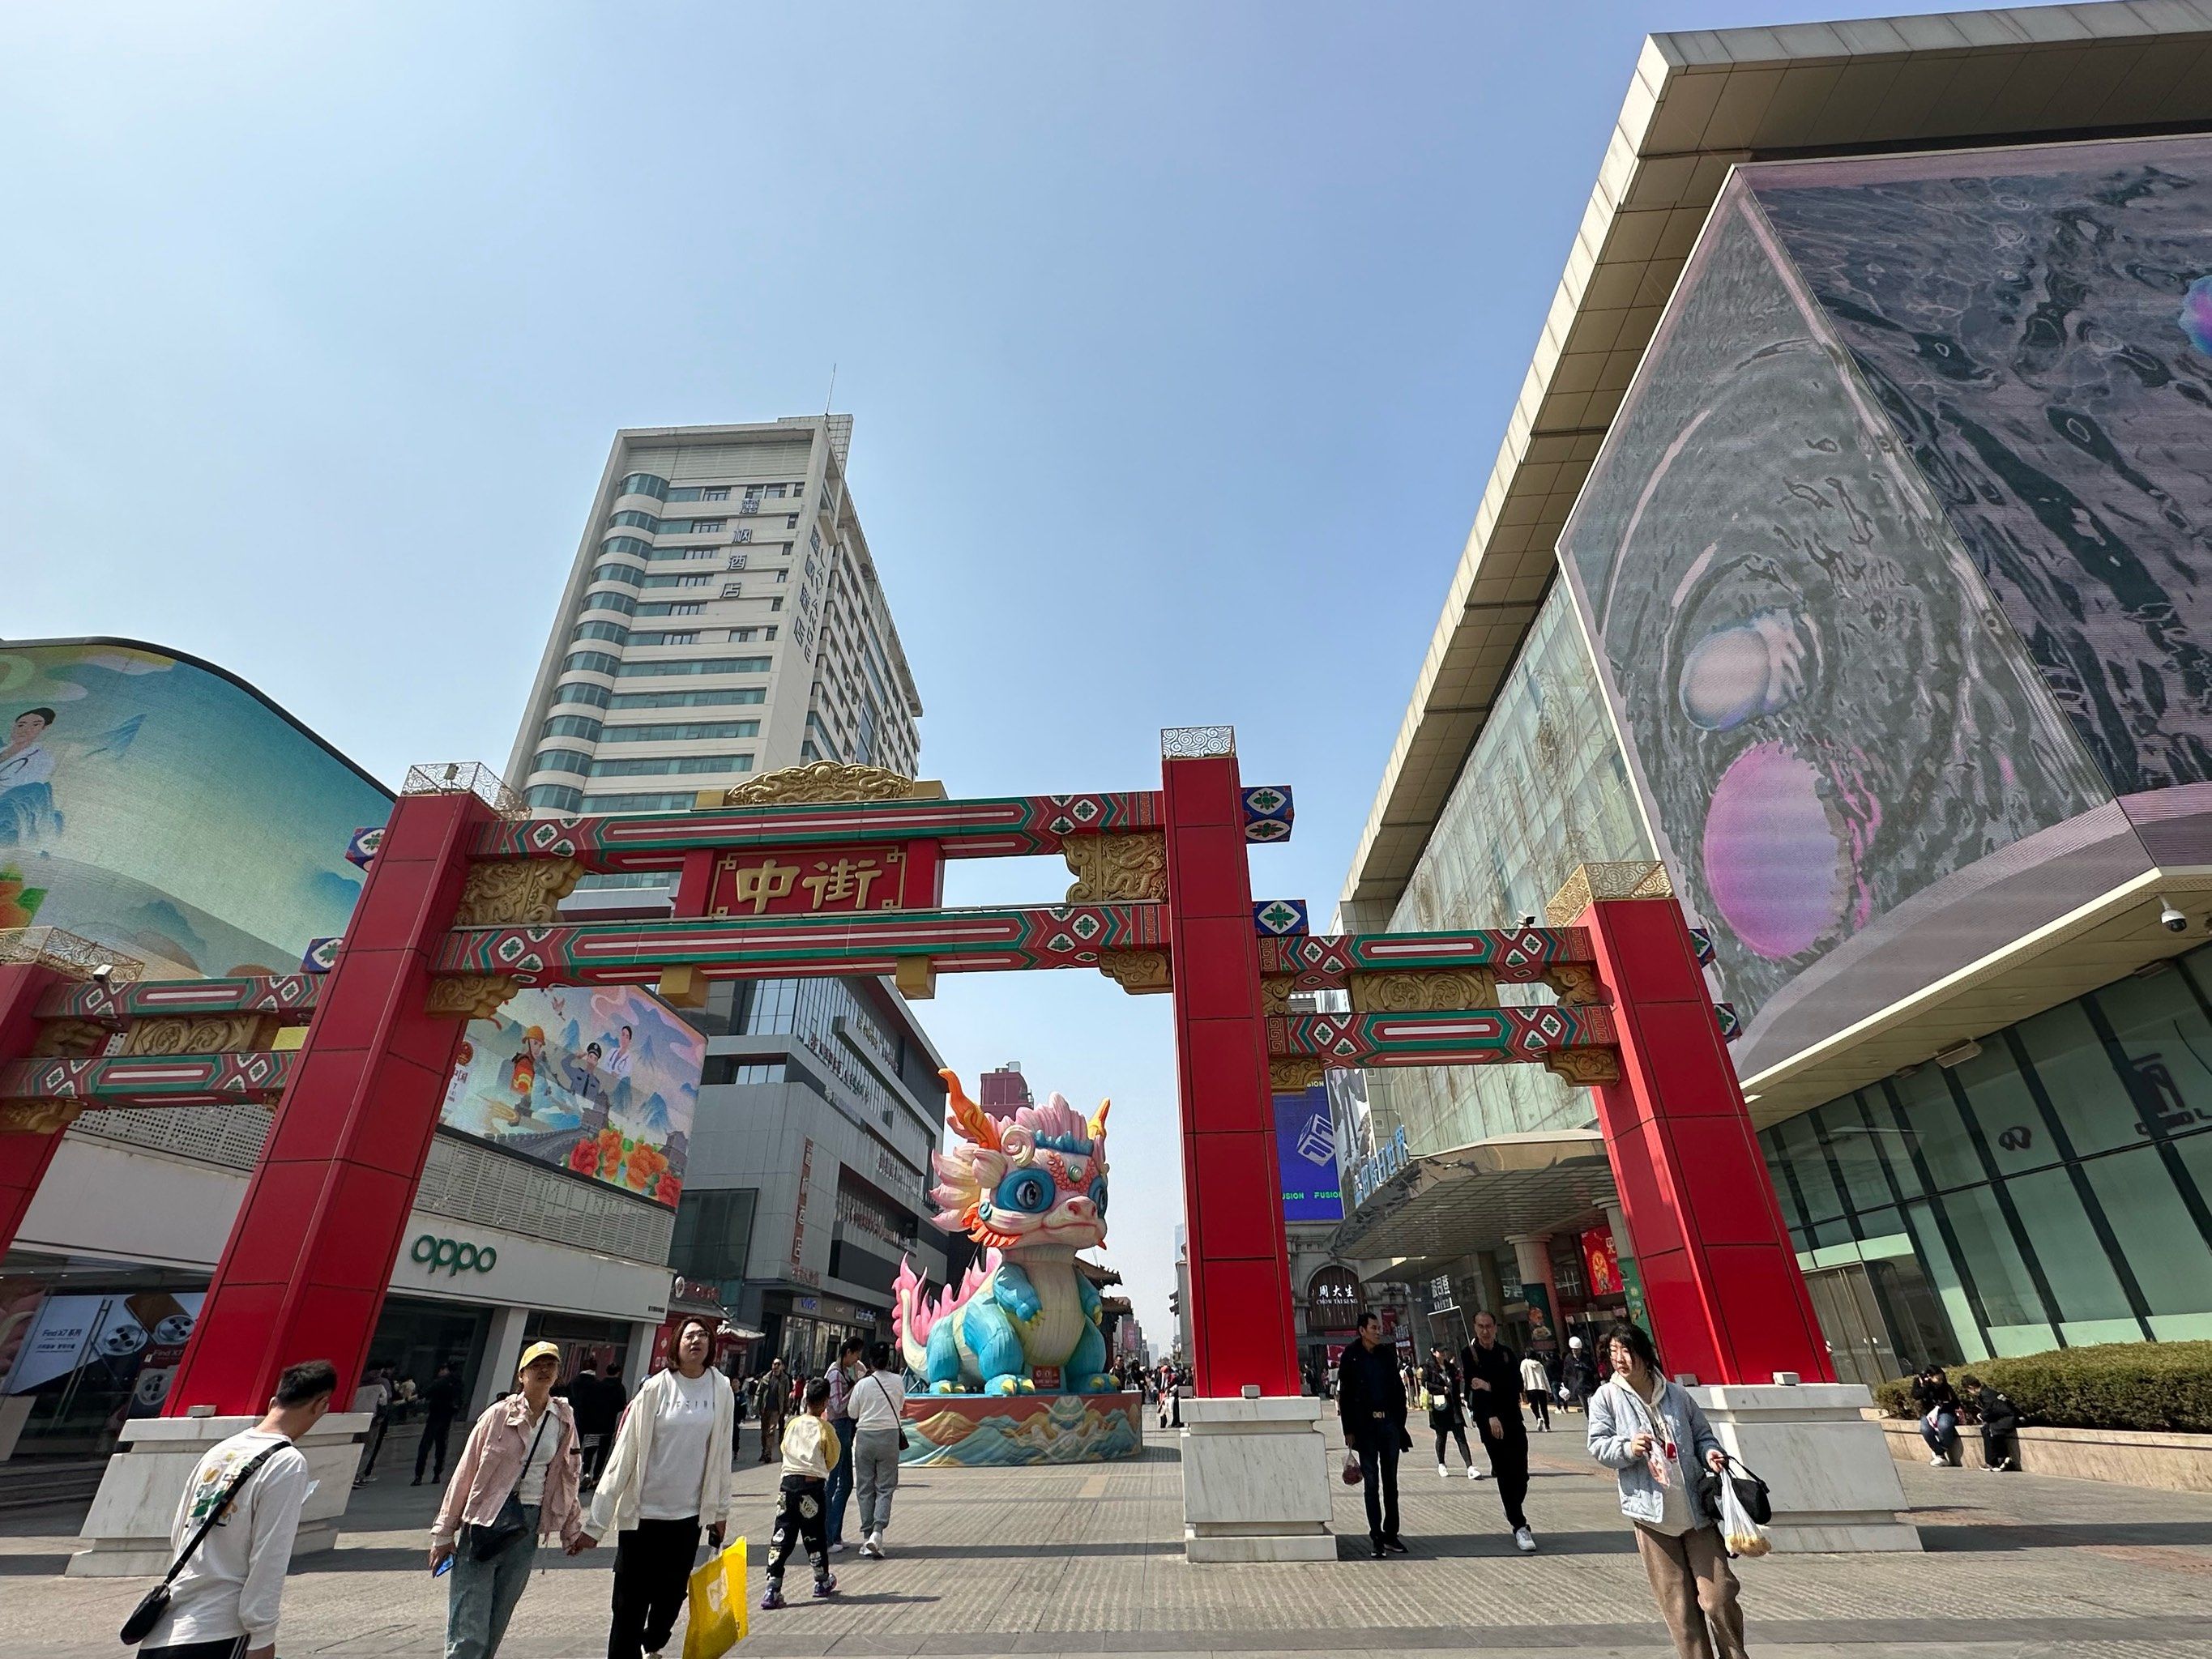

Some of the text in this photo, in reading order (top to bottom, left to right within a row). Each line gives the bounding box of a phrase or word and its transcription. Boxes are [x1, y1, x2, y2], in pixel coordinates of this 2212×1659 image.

[736, 859, 882, 914] 中街
[1319, 1284, 1354, 1298] 周大生
